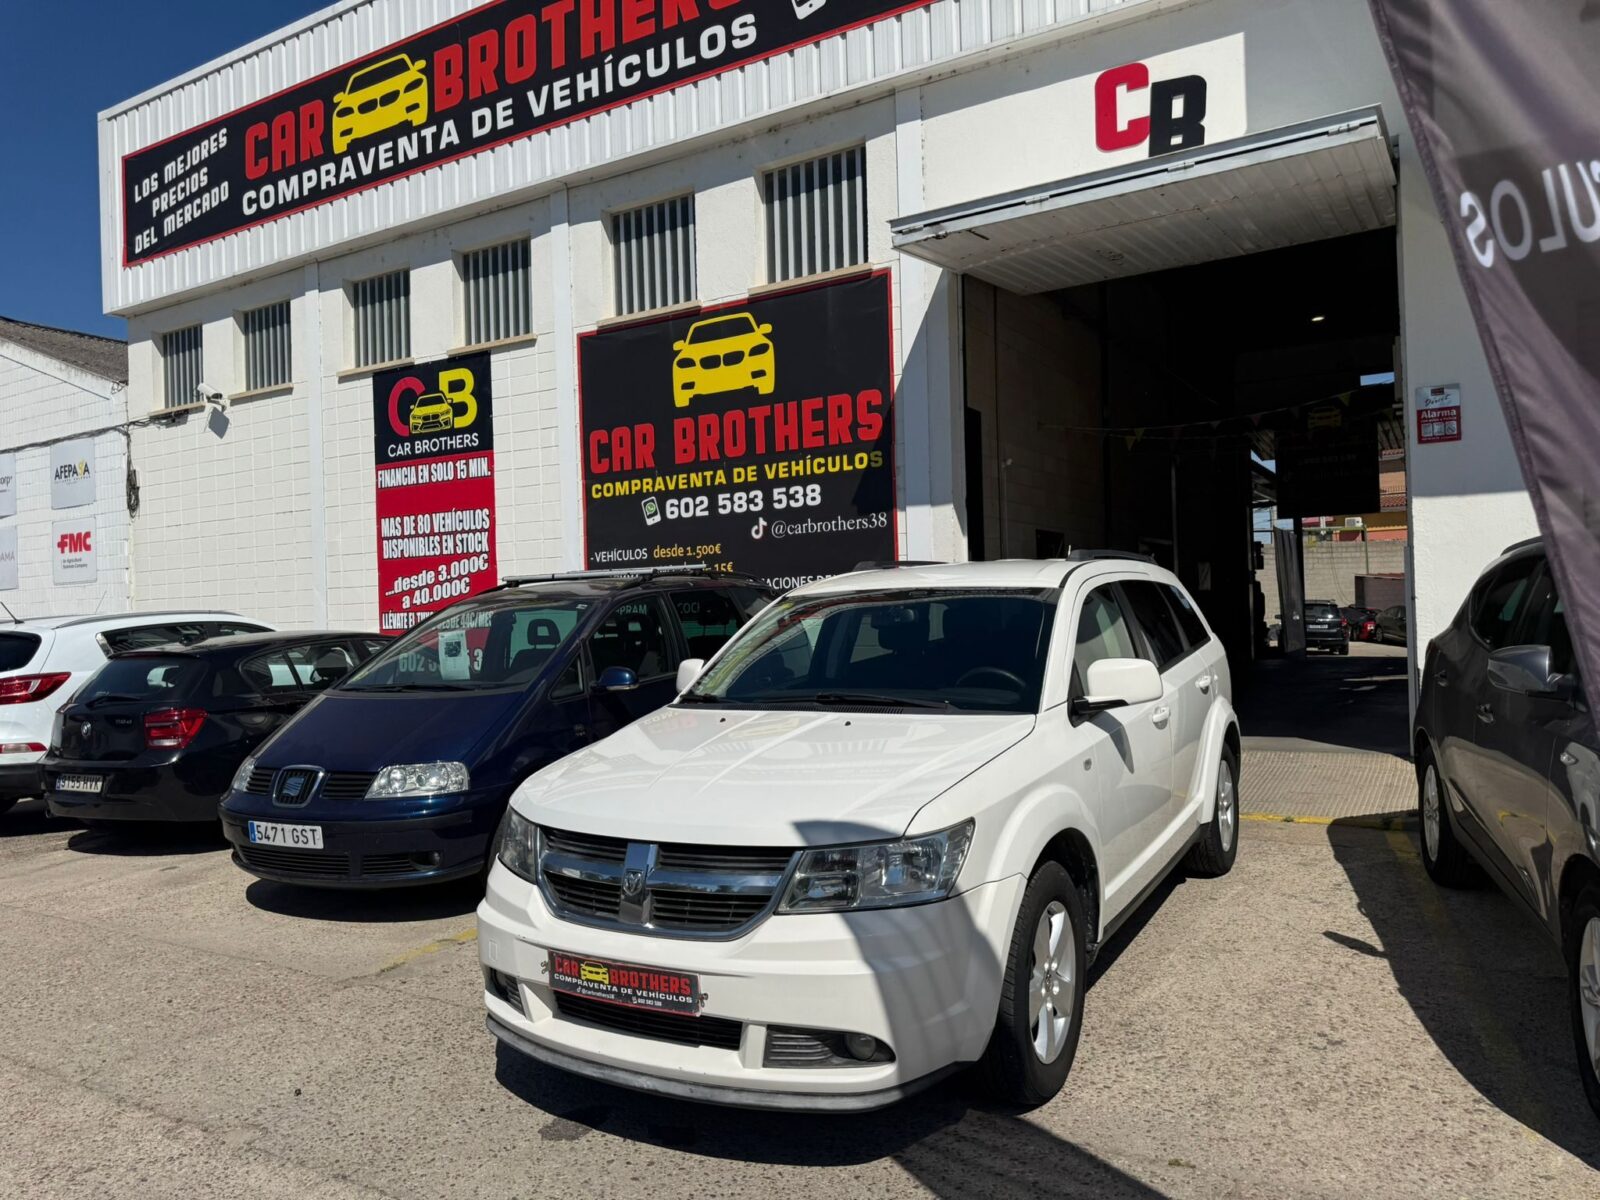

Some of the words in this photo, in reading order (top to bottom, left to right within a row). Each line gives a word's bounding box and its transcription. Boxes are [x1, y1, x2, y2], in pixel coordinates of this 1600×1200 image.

[244, 99, 325, 181] CAR
[433, 0, 742, 112] BROTHE
[242, 118, 460, 217] COMPRAVENTA
[471, 98, 514, 138] DE
[526, 13, 757, 119] VEHÍCULOS
[1094, 62, 1208, 158] CB
[134, 176, 159, 204] LOS
[164, 127, 228, 184] MEJORES
[152, 166, 209, 218] PRECIOS
[134, 228, 158, 254] DEL
[163, 181, 229, 238] MERCADO
[1421, 408, 1457, 418] Alarma
[388, 444, 412, 458] CAR
[415, 432, 479, 455] BROTHERS
[589, 423, 655, 474] CAR
[673, 389, 883, 465] BROTHERS
[377, 465, 417, 489] FINANCIA
[418, 463, 429, 484] EN
[430, 461, 454, 482] SOLO
[455, 459, 467, 480] 15
[468, 457, 491, 478] MIN.
[591, 469, 727, 499] COMPRAVENTA
[733, 465, 758, 483] DE
[764, 451, 883, 480] VEHÍCULOS
[665, 497, 709, 519] 602
[717, 490, 764, 515] 583
[772, 484, 822, 507] 538
[381, 516, 402, 538] MAS
[403, 515, 416, 536] DE
[417, 513, 431, 534] 80
[432, 507, 490, 533] VEHÍCULOS
[771, 512, 888, 538] @carbrothers38
[57, 531, 92, 554] FMC
[383, 534, 440, 559] DISPONIBLES
[442, 533, 454, 555] EN
[455, 531, 489, 554] STOCK
[653, 545, 684, 558] desde
[686, 543, 721, 559] 1.500€
[438, 553, 488, 581] 3.000€
[402, 595, 411, 609] a
[412, 577, 470, 606] 40.000€
[382, 609, 407, 630] LLÉVATE
[256, 825, 287, 842] 5471
[292, 827, 317, 846] GST
[553, 973, 618, 993] COMPRAVENTA
[620, 987, 633, 995] DE
[636, 989, 693, 1004] VEHÍCULOS
[554, 956, 579, 978] CAR
[609, 968, 691, 995] BROTHERS
